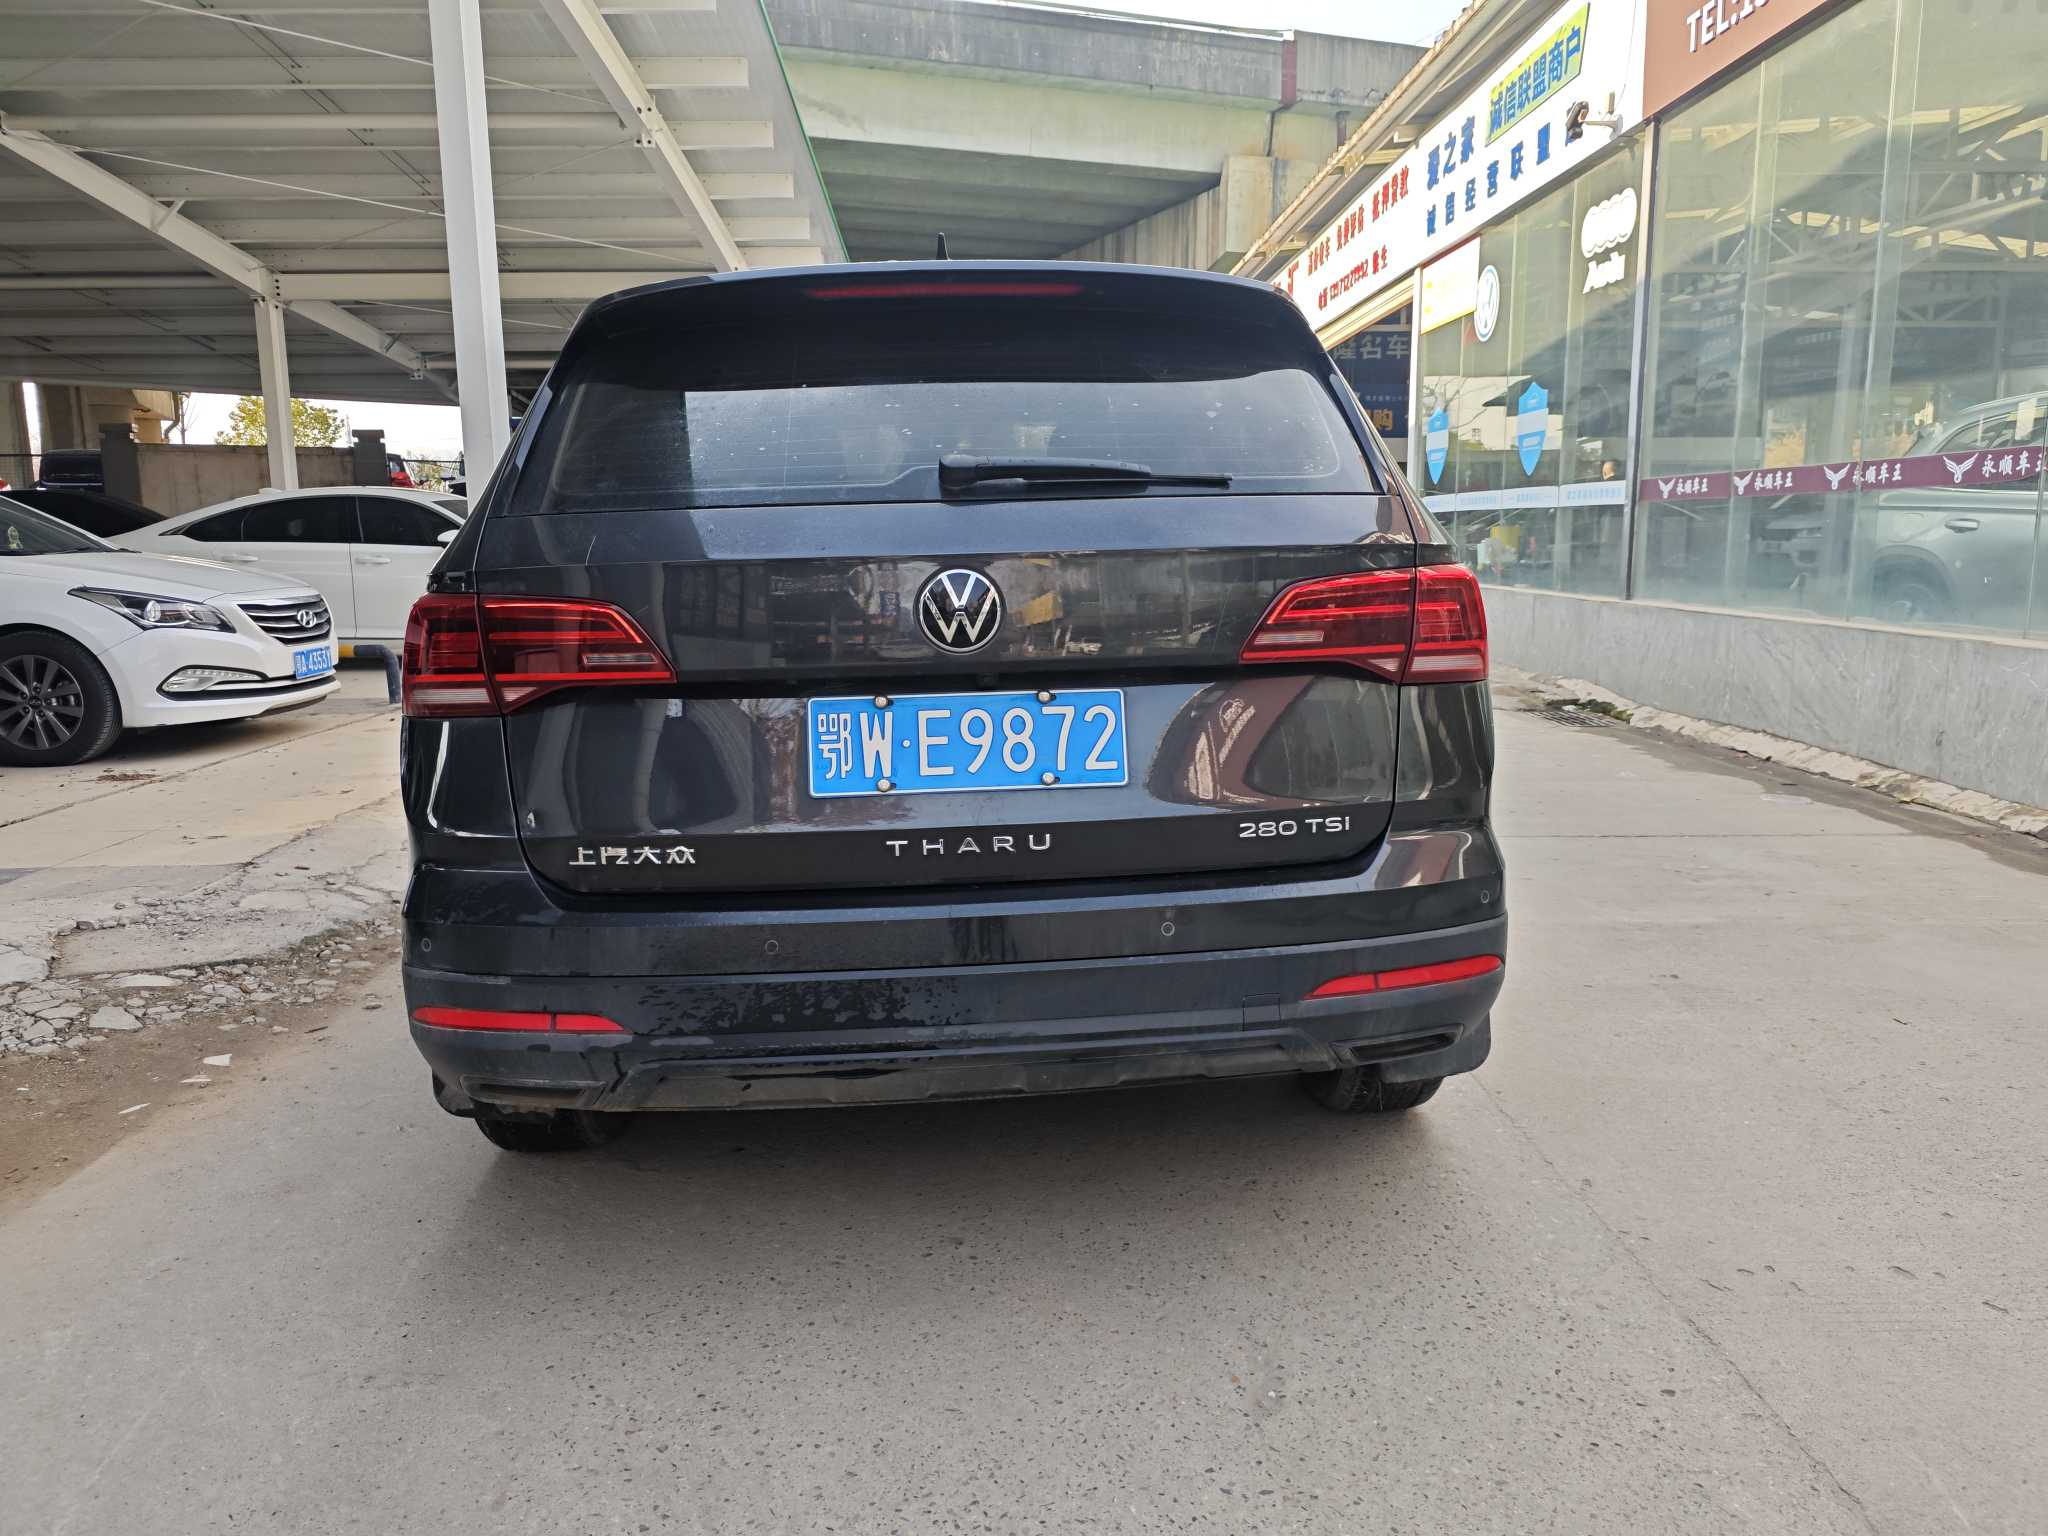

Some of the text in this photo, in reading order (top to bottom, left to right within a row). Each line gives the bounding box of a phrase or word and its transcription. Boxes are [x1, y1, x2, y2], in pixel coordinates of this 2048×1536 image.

[1686, 0, 1770, 53] TEL:
[1489, 25, 1582, 137] 诚信联盟商户
[1426, 102, 1588, 238] 诚信经营联盟
[817, 704, 1119, 779] 鄂W·E9872
[885, 833, 1051, 857] THARU
[1239, 816, 1350, 838] 280 TSI
[568, 845, 696, 866] 上汽大众
